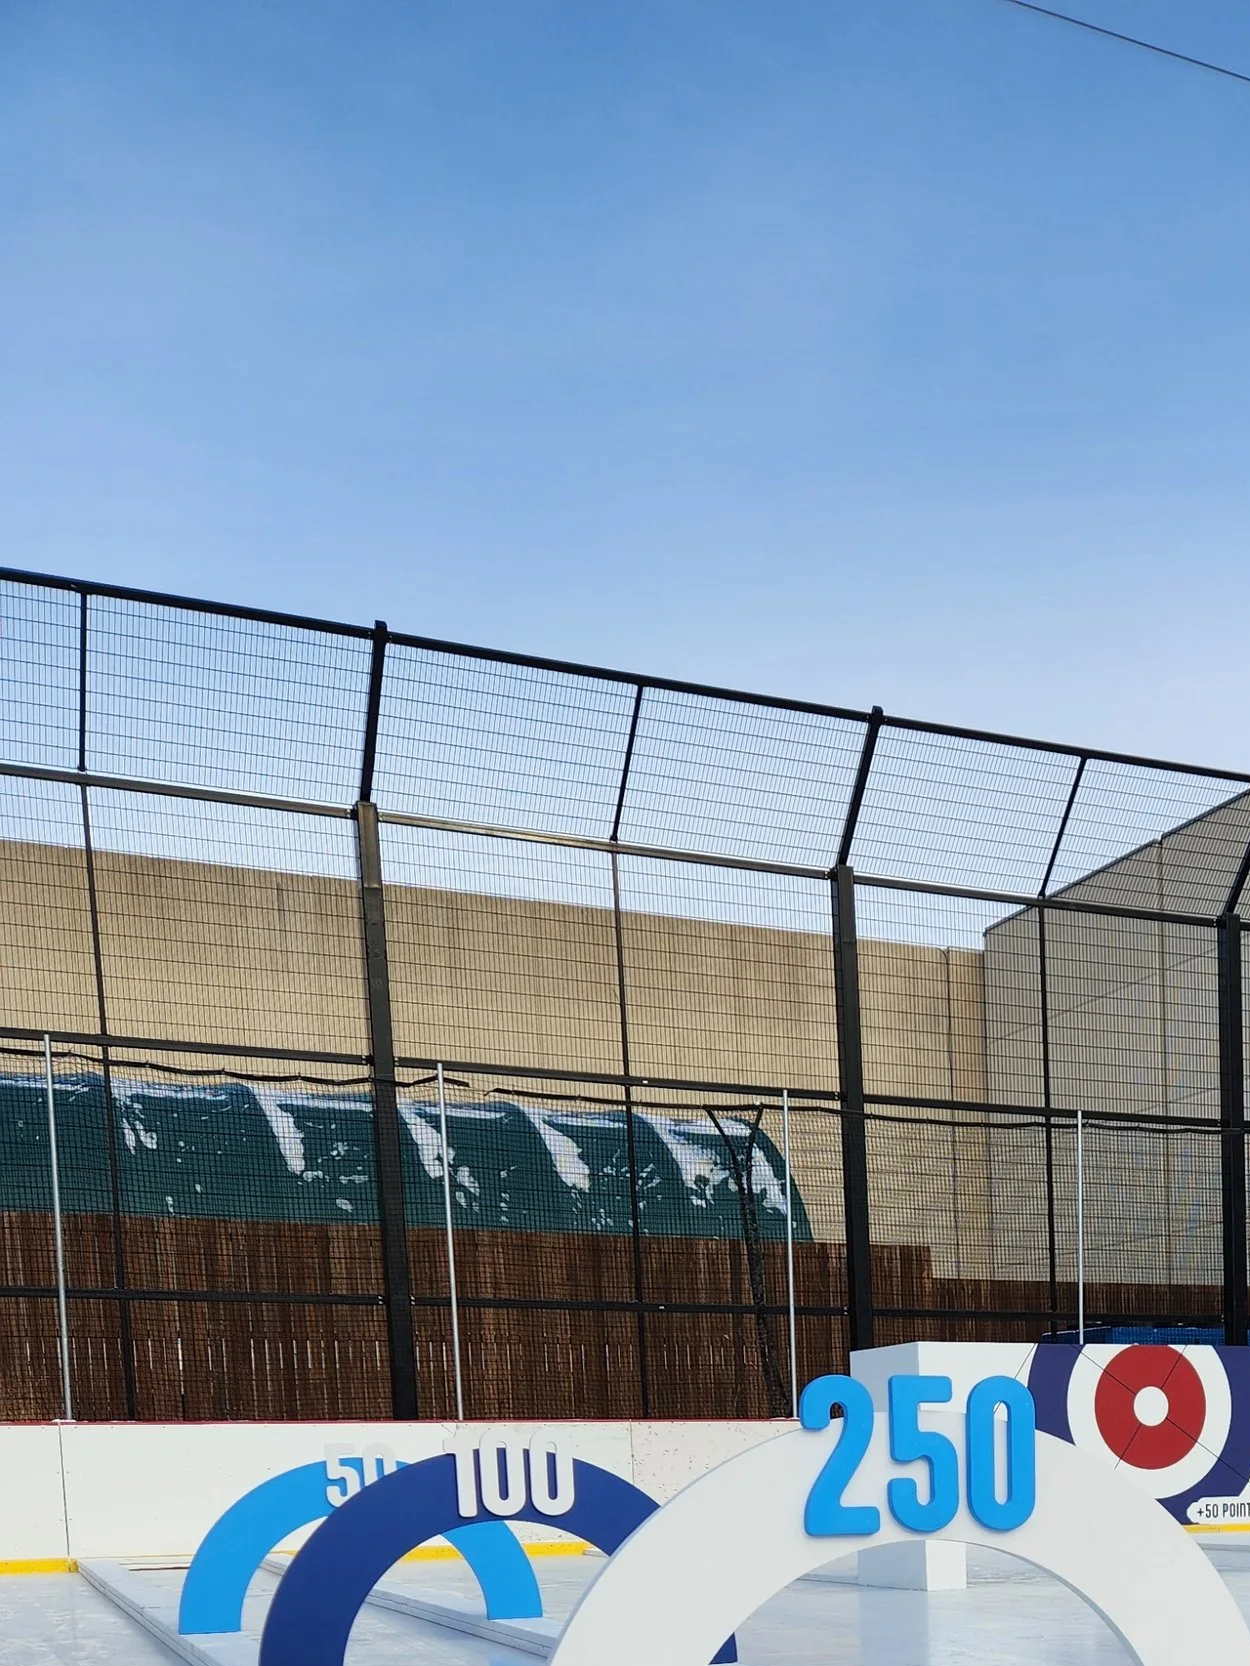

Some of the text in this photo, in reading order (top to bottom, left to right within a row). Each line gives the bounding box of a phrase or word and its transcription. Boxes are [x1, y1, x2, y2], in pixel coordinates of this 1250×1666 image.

[442, 1428, 575, 1518] 100
[799, 1374, 1036, 1536] 250
[1197, 1503, 1219, 1519] +50
